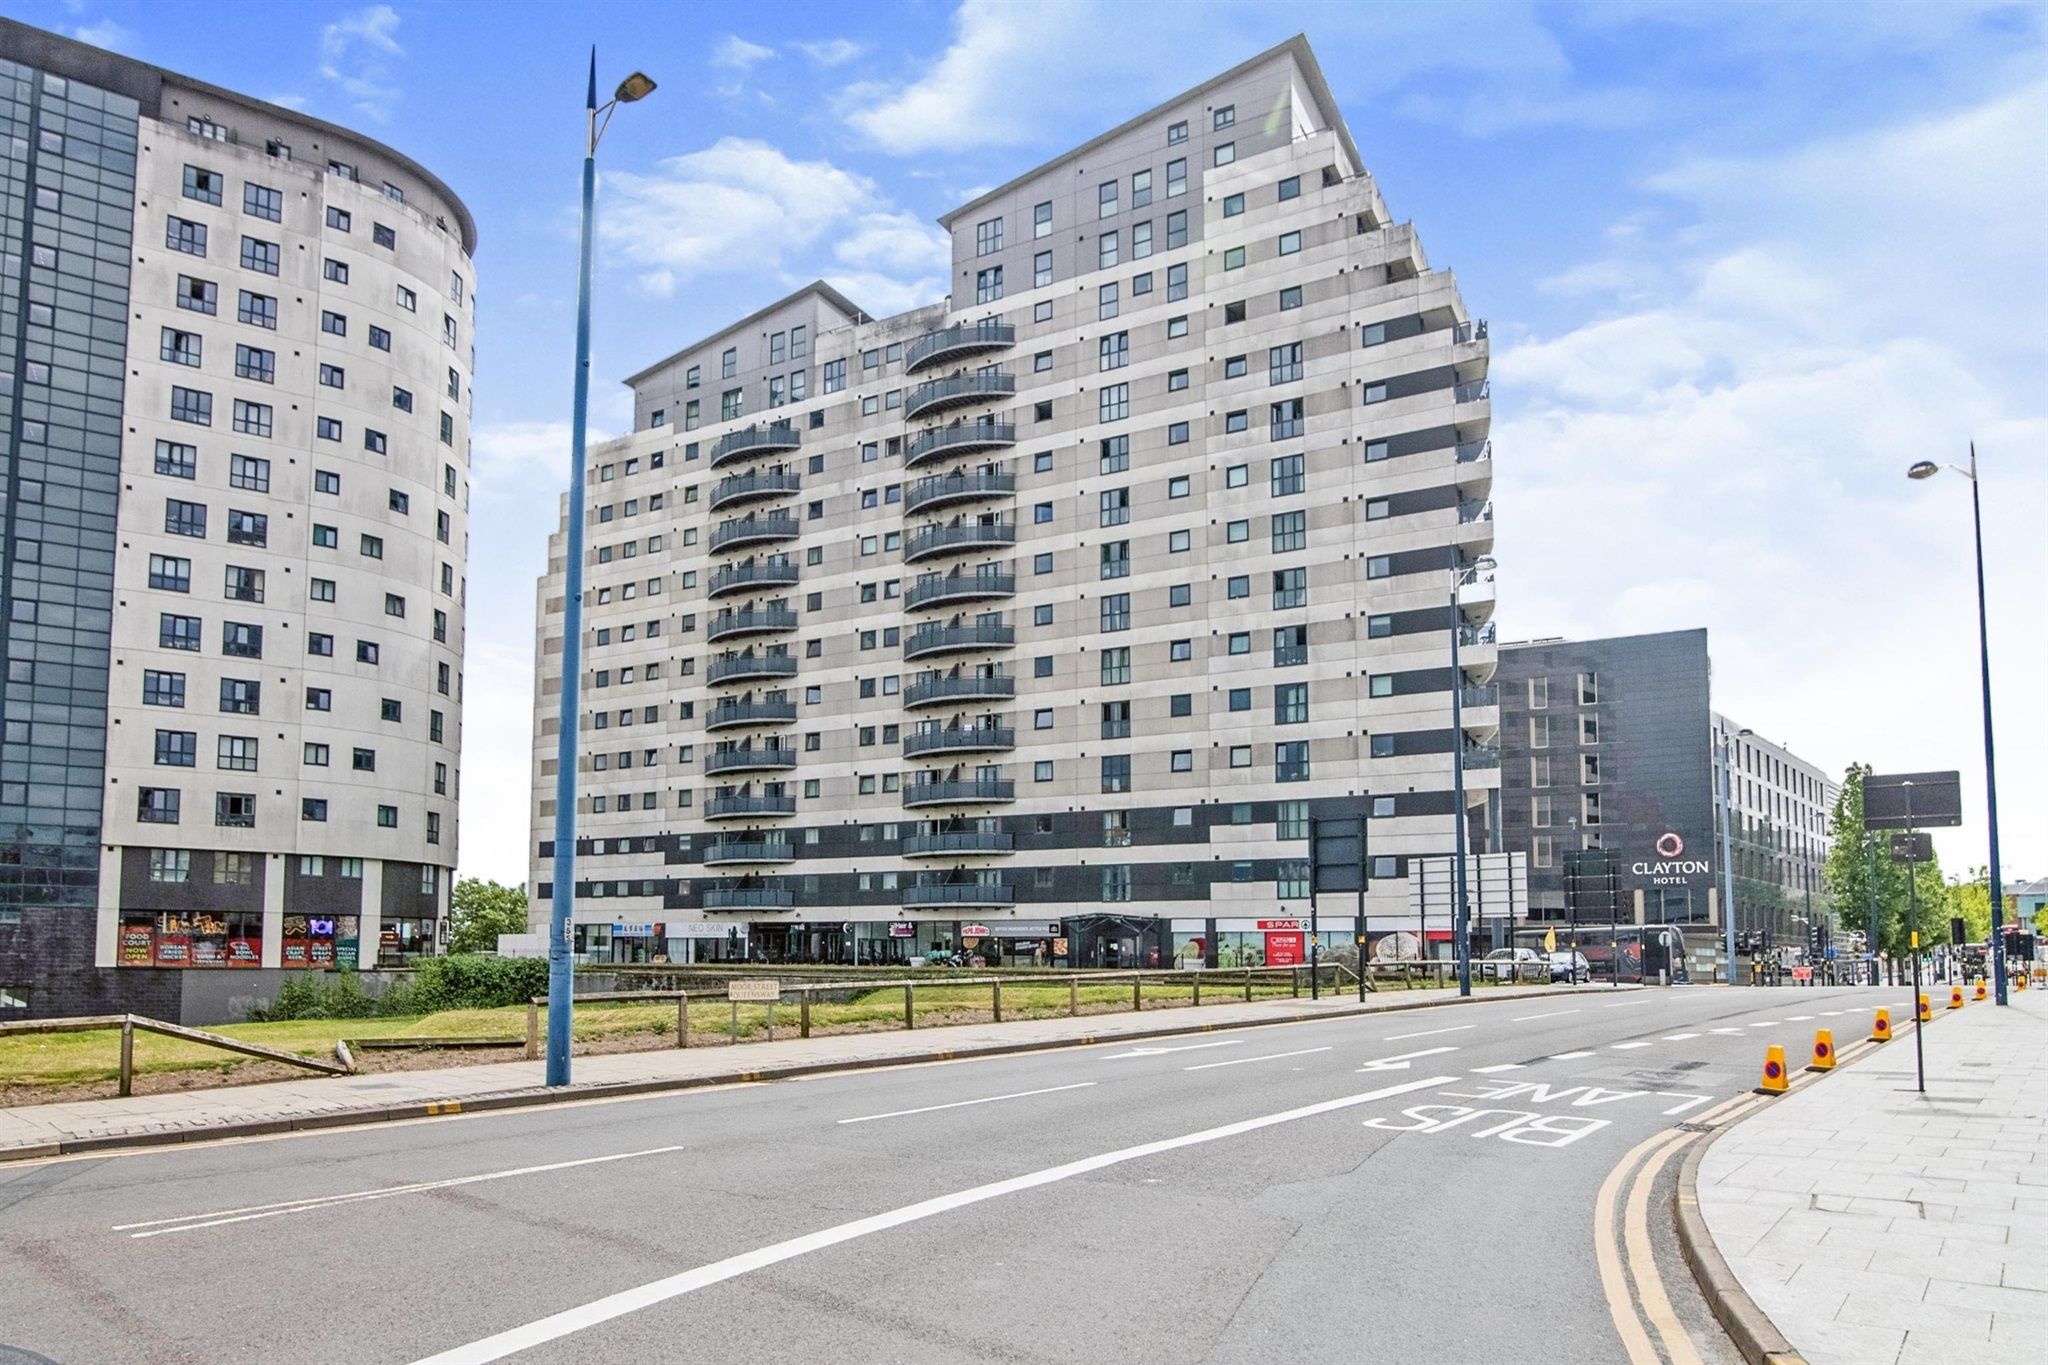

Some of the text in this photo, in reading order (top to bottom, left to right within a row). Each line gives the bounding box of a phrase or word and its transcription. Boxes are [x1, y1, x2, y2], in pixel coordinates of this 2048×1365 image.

[1632, 861, 1709, 875] CLAYTON
[1653, 877, 1688, 885] HOTEL
[688, 923, 724, 932] NEO SKIN
[1266, 921, 1299, 929] SPAR
[1439, 1079, 1714, 1115] LANE
[1363, 1105, 1612, 1147] BUS
